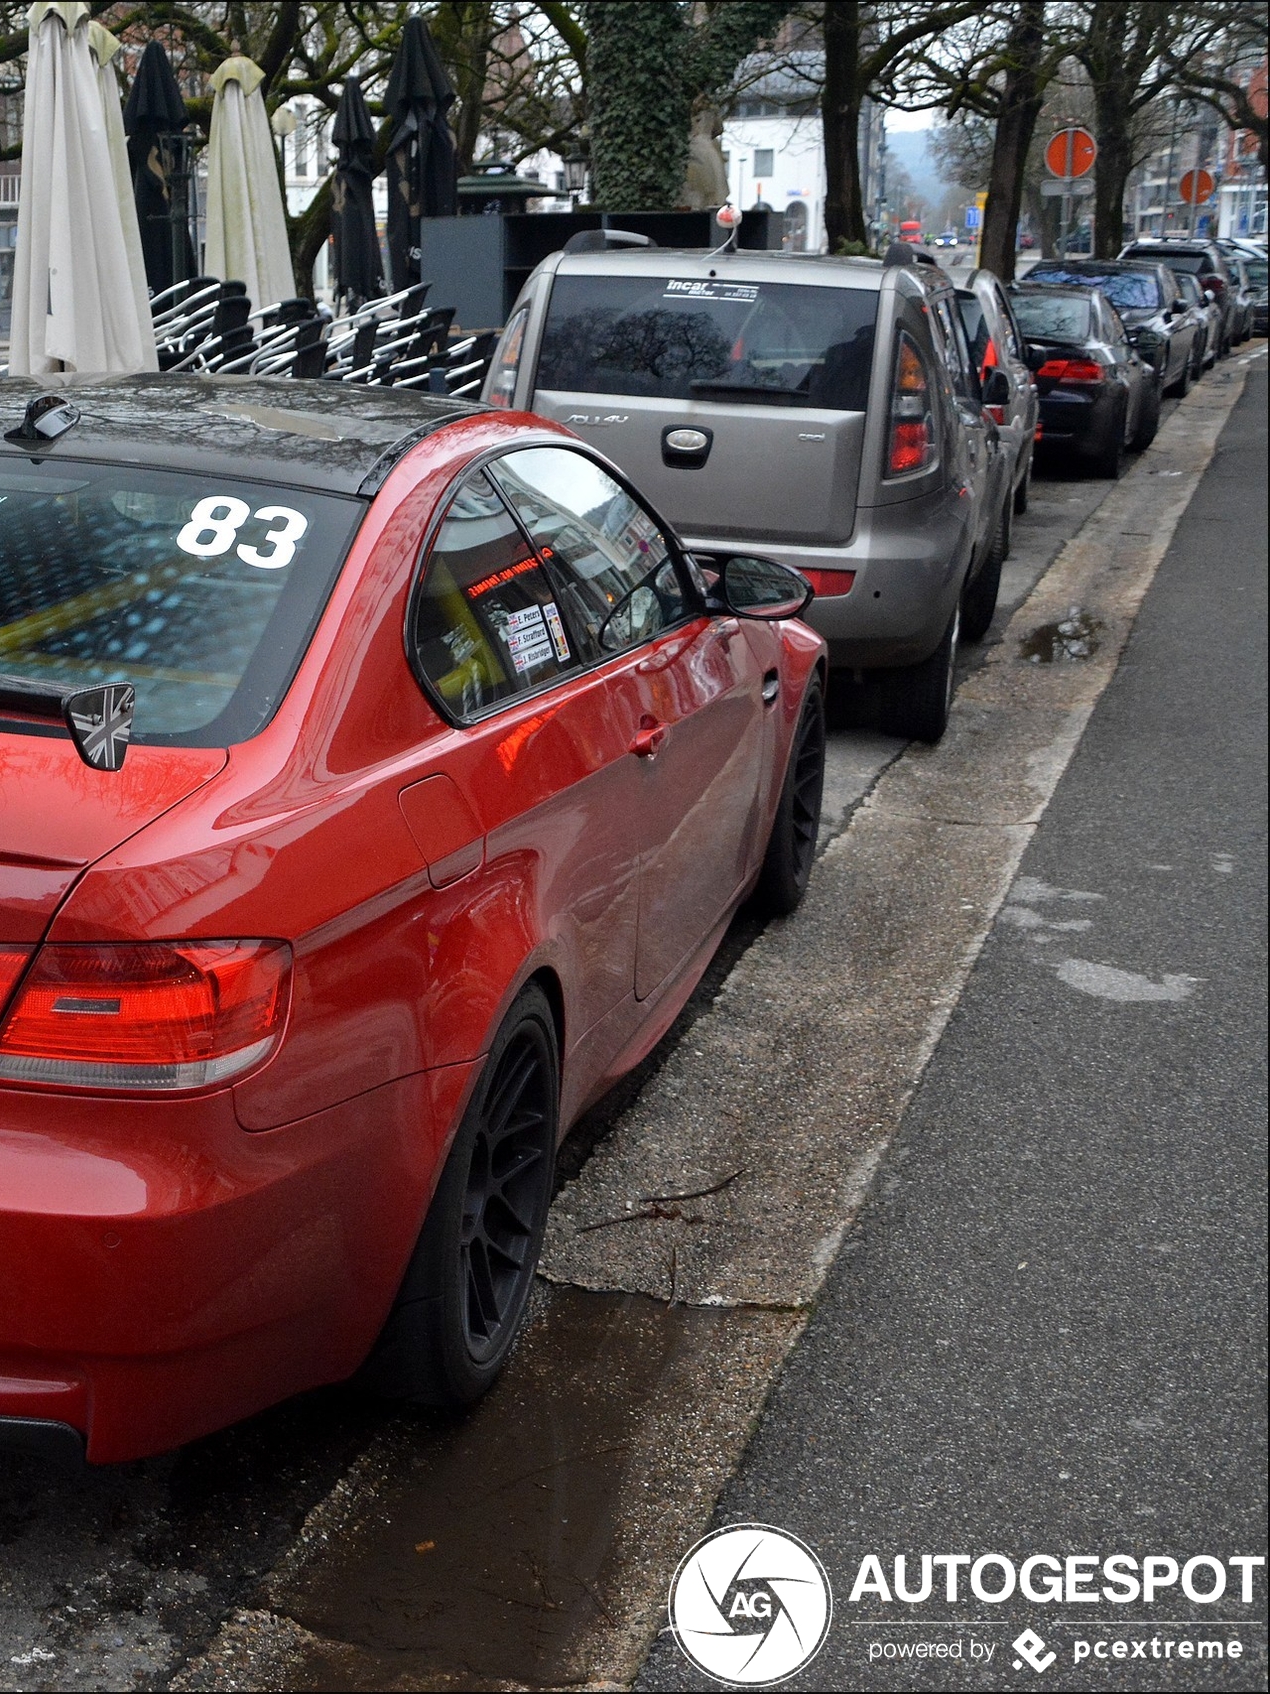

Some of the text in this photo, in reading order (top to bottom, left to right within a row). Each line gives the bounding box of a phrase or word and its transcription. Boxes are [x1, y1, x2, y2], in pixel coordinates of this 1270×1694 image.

[176, 495, 309, 569] 83
[524, 609, 541, 623] Peters
[523, 628, 546, 644] Strafford
